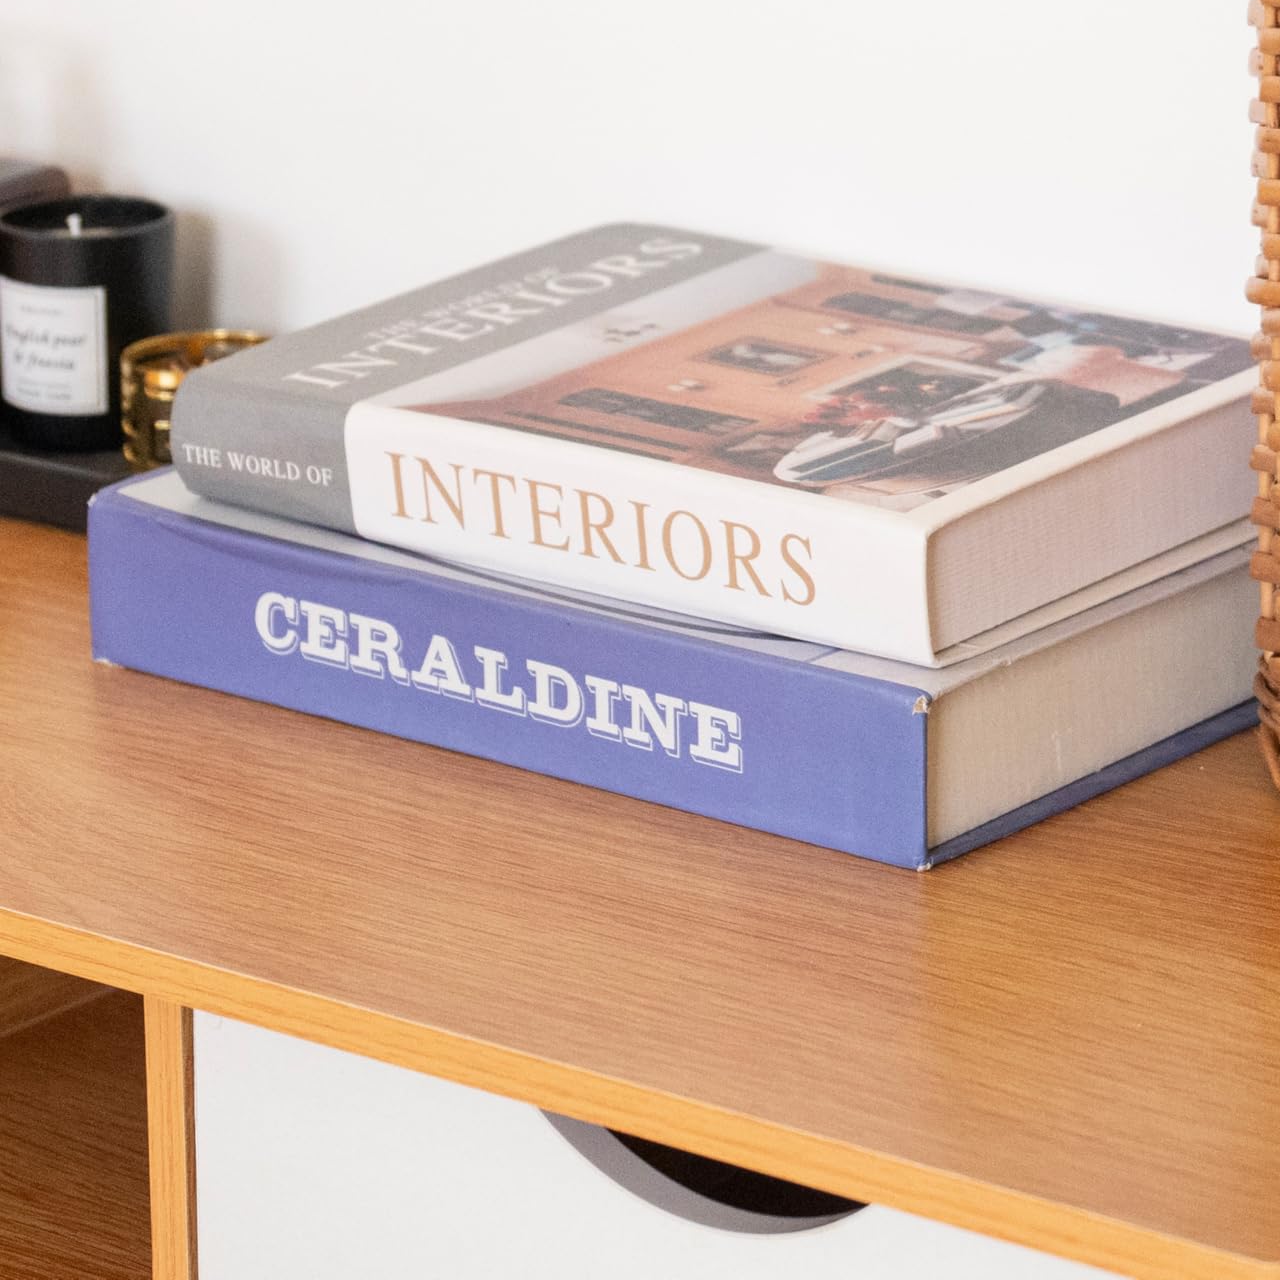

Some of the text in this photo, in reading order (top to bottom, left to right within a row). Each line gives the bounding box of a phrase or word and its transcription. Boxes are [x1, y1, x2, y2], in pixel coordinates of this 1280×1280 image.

[282, 237, 703, 390] INTERIORS
[181, 442, 333, 487] THE WORLD OF
[383, 450, 817, 607] INTERIORS
[254, 590, 744, 775] CERALDINE
